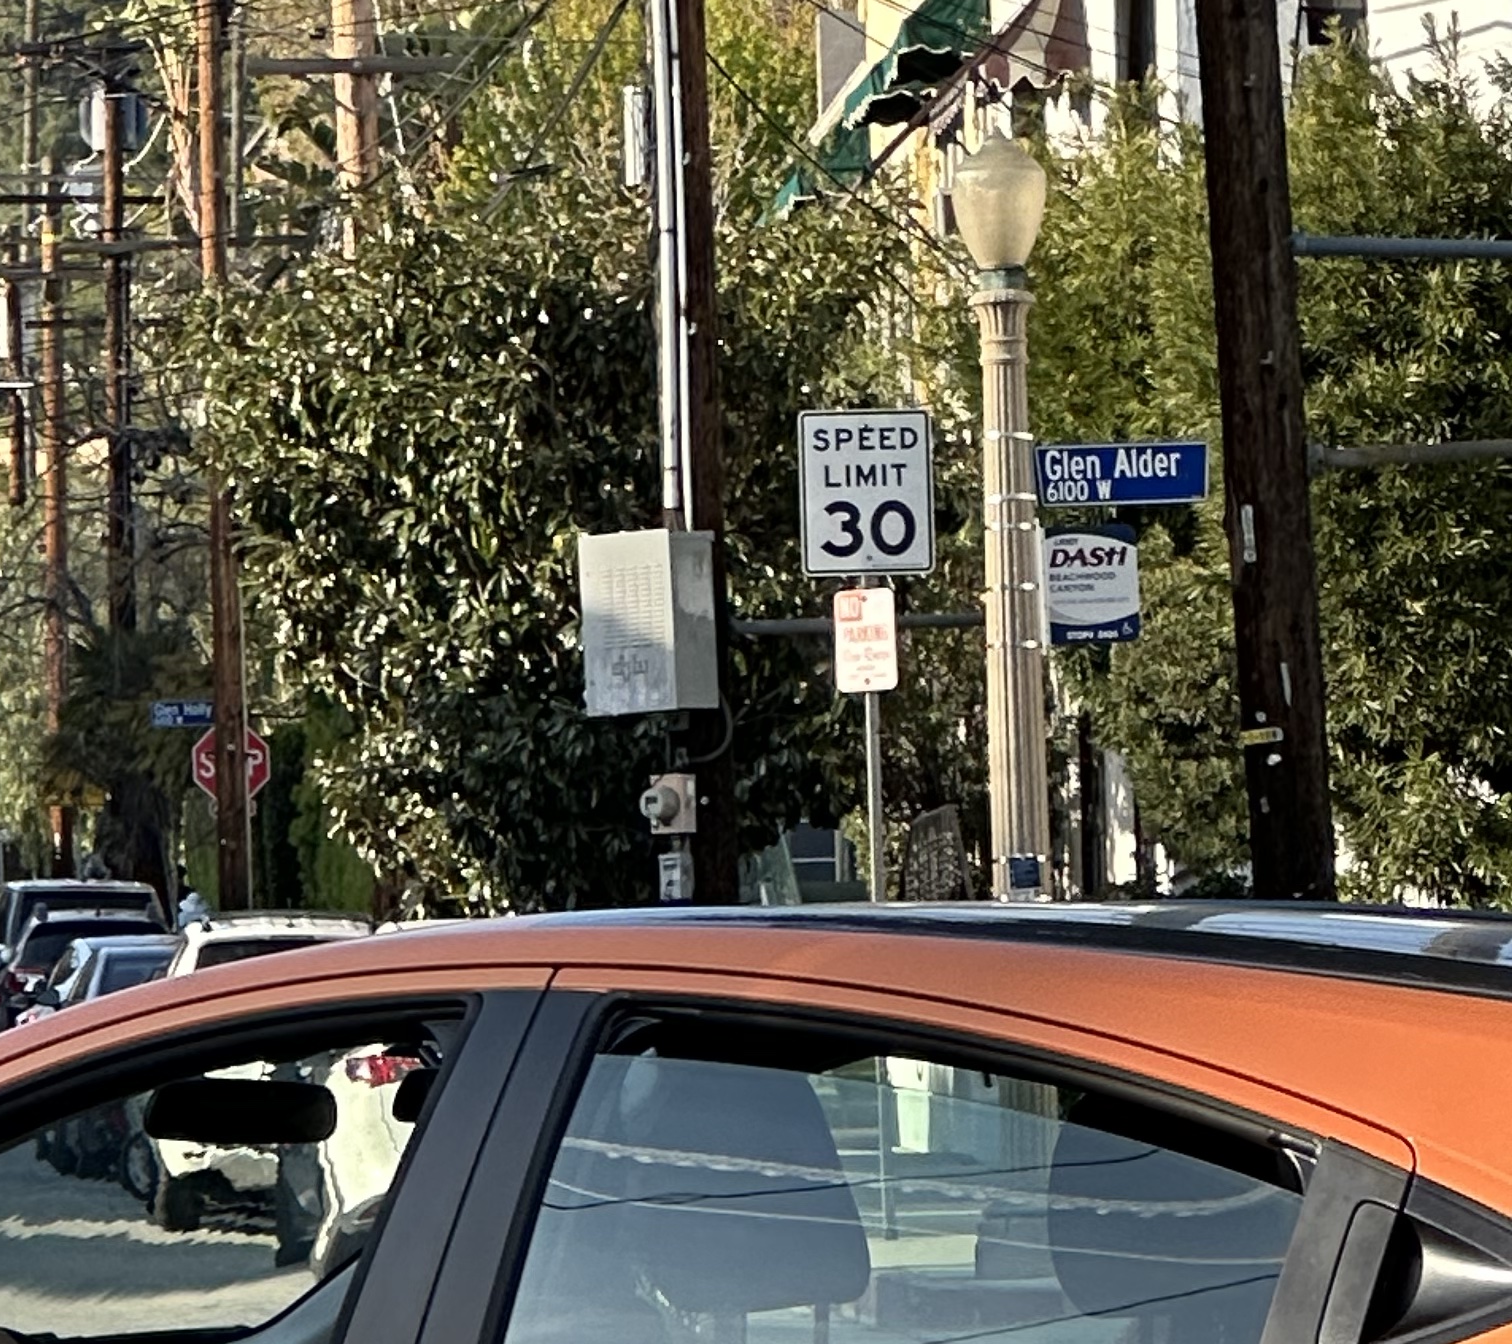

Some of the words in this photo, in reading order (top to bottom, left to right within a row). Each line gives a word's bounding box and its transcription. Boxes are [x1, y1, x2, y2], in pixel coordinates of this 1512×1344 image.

[813, 427, 919, 452] SPEED
[824, 463, 907, 487] LIMIT
[1045, 450, 1101, 481] Glen
[1114, 448, 1181, 478] Alder
[1046, 480, 1089, 502] 6100
[1096, 479, 1112, 500] W
[820, 500, 916, 557] 30
[1050, 546, 1128, 568] DASH
[199, 749, 264, 778] SP
